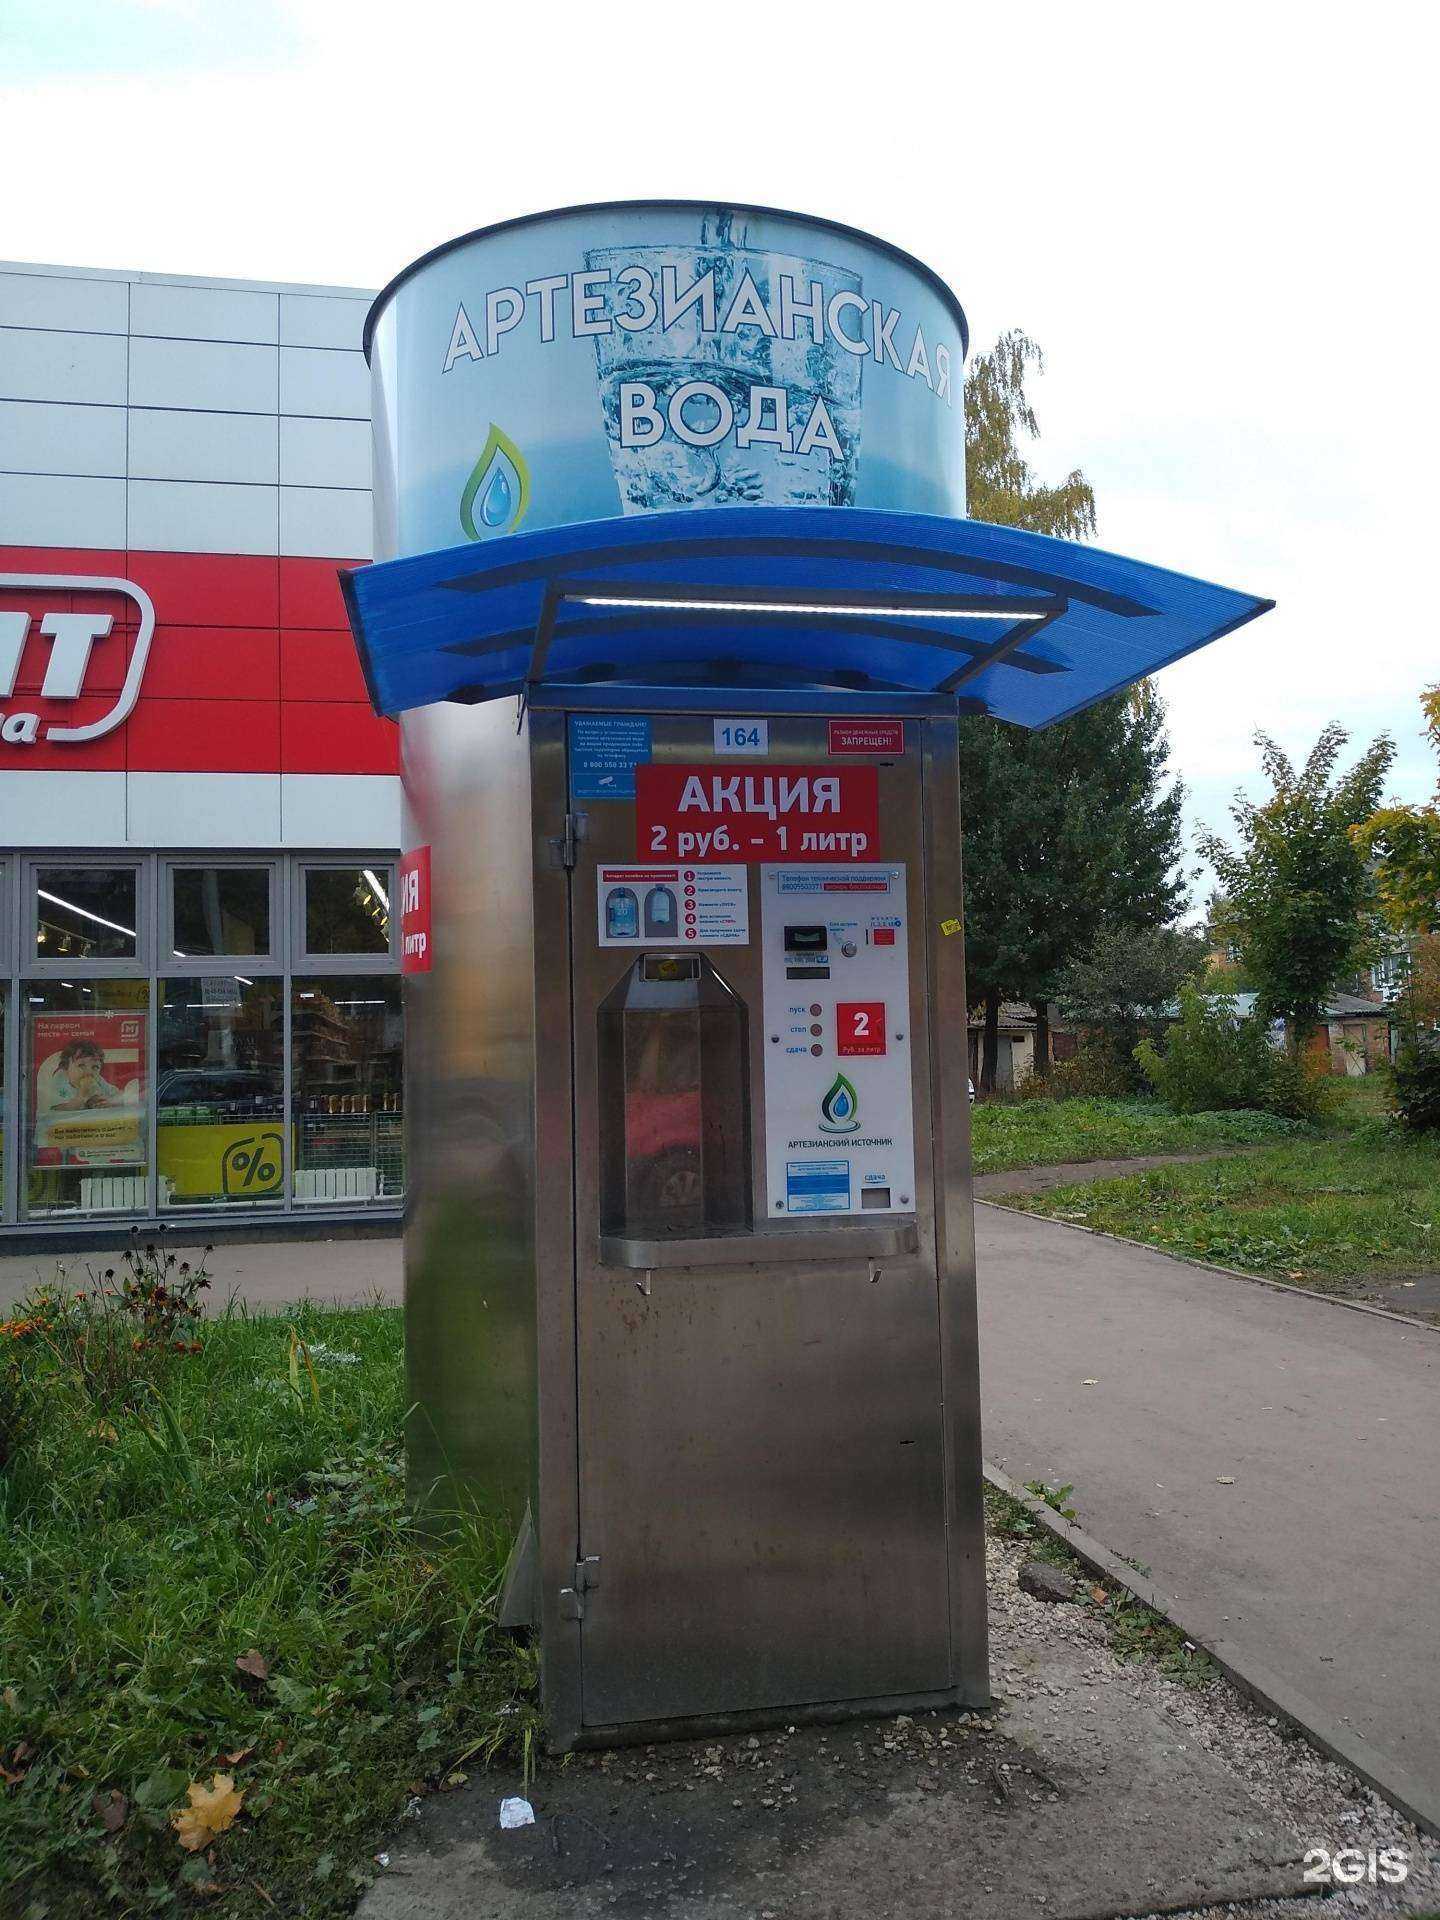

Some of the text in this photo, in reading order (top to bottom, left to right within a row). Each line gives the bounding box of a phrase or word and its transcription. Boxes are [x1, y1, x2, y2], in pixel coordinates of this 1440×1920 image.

[441, 265, 951, 407] АРТЕЗИАНСКАЯ
[619, 381, 844, 461] ВОДА
[722, 727, 760, 746] 164
[841, 736, 892, 747] ЗАПРЕЩЕН!
[678, 776, 840, 821] АКЦИЯ
[651, 825, 668, 851] 2
[678, 825, 739, 857] руб.
[776, 826, 788, 851] 1
[801, 832, 868, 857] литр
[854, 1012, 869, 1036] 2
[788, 1138, 893, 1149] АРТЕЗИАНСКИЙ ИСТОЧНИК
